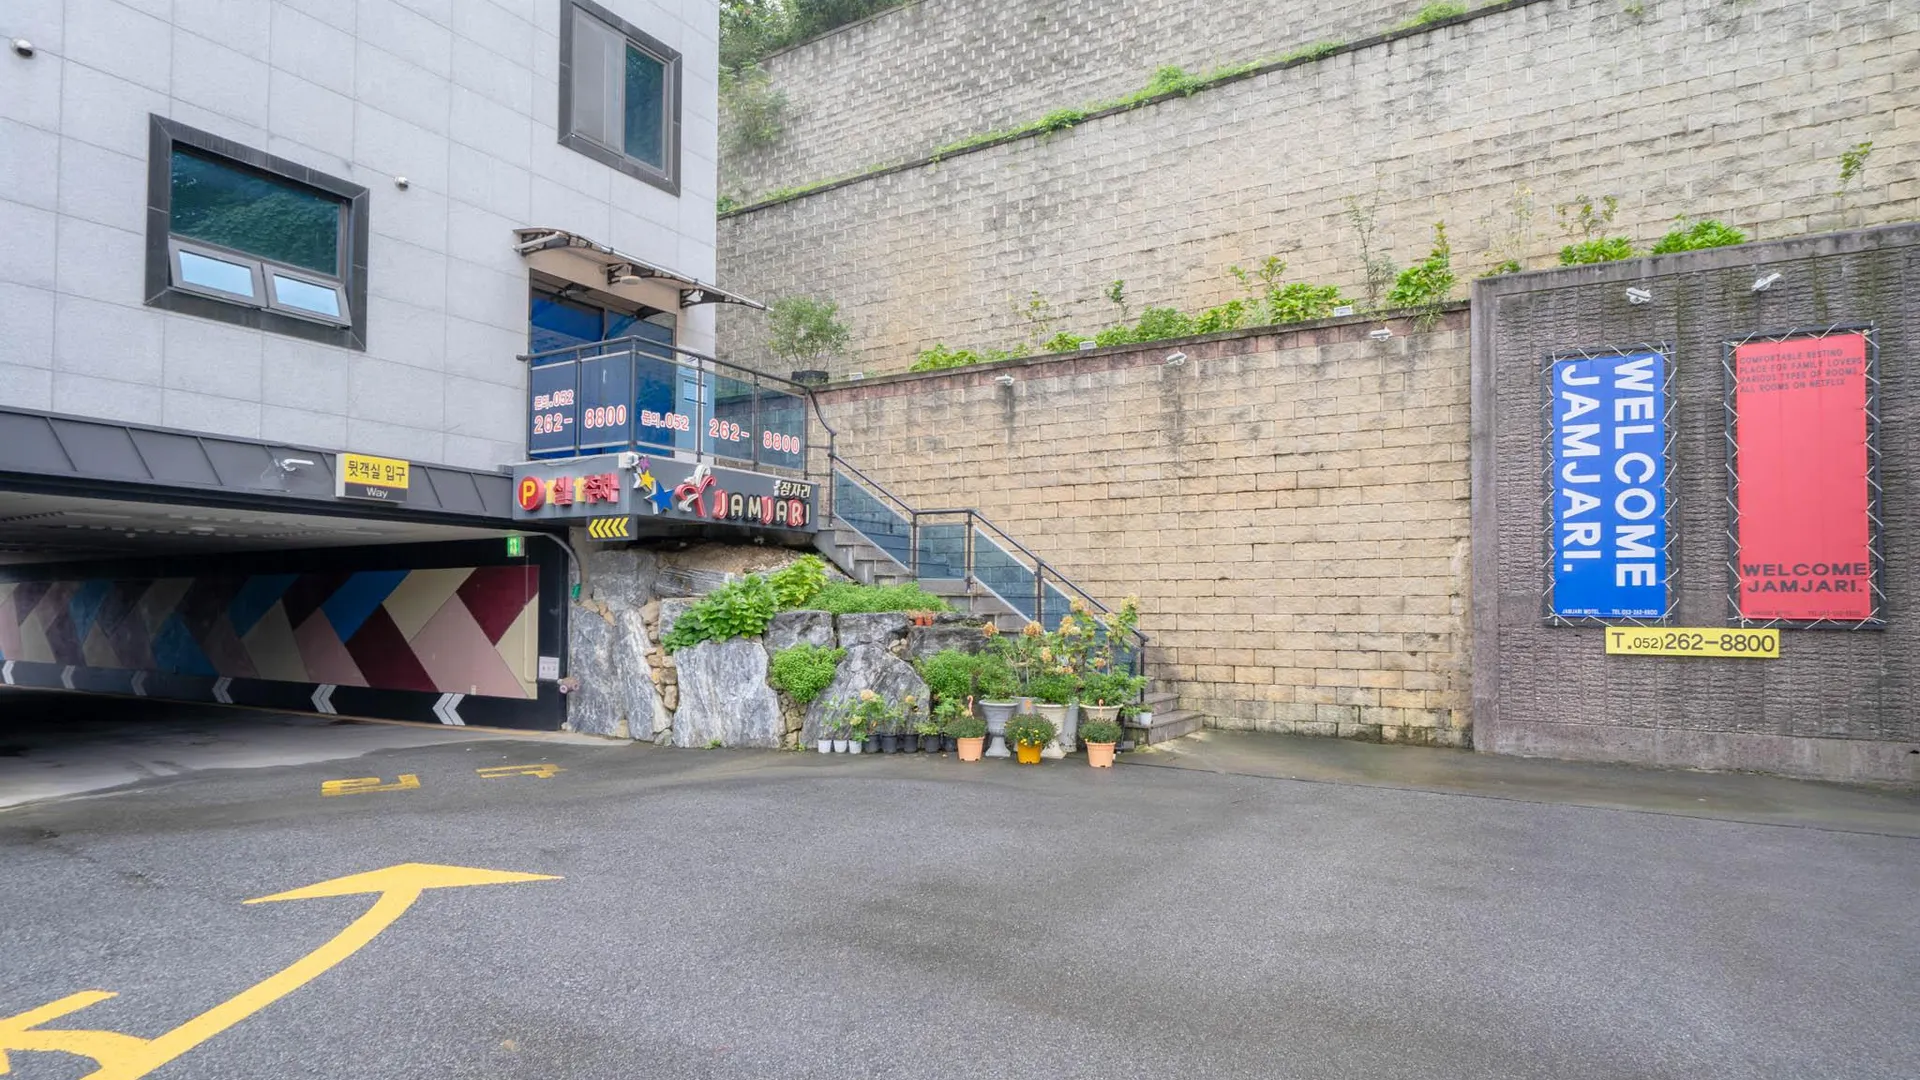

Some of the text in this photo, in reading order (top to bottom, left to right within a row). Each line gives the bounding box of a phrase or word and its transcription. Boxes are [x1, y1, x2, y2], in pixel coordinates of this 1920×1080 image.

[1740, 364, 1766, 374] PLACE
[1771, 362, 1787, 371] FOR
[533, 404, 627, 435] 262- 8800
[709, 418, 750, 442] 262-
[763, 430, 800, 455] 8800
[348, 460, 406, 482] 뒷객실 입구
[1561, 364, 1601, 572] JAMJARI.
[1614, 357, 1656, 587] WELCOME
[366, 486, 389, 499] Way
[780, 481, 812, 498] 잠자리
[712, 488, 811, 527] JAMJARI
[1742, 563, 1867, 577] WELCOME
[1747, 579, 1863, 592] JAMJARI.
